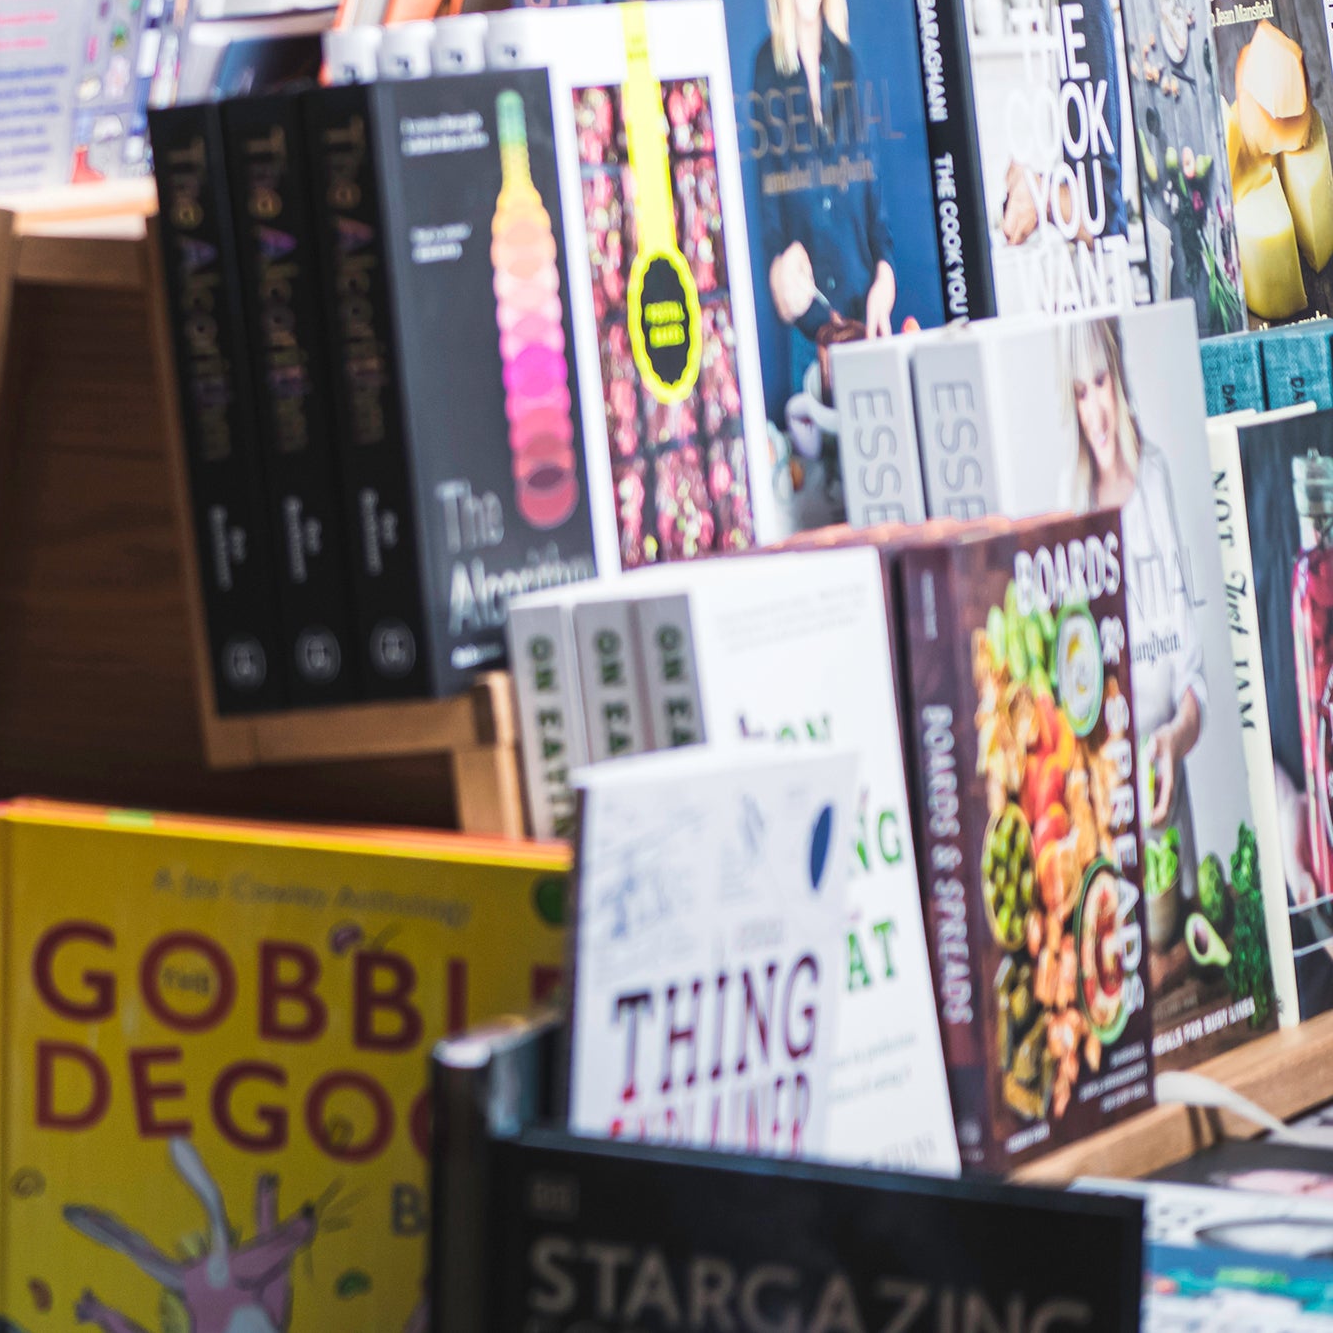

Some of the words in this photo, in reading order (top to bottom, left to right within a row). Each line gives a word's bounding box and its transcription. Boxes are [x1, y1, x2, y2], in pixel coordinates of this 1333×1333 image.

[1008, 2, 1091, 81] THE
[735, 78, 907, 164] SSENTIAL
[1005, 78, 1116, 163] COOK
[933, 150, 957, 201] THE
[1023, 159, 1107, 241] YOU
[938, 200, 964, 270] COOK
[1015, 231, 1136, 319] WANT
[945, 266, 968, 316] YOU
[1013, 530, 1121, 617] BOARDS
[1213, 469, 1236, 547] NOT
[1234, 655, 1257, 732] JAM
[922, 704, 961, 838] BOARDS
[931, 842, 962, 872] &
[1104, 691, 1146, 1015] SPREADS
[933, 876, 974, 1025] SPREADS
[609, 951, 820, 1104] THING
[1184, 1019, 1203, 1043] FOR
[34, 1037, 432, 1163] DEGO
[529, 1235, 1094, 1333] STARGAZING
